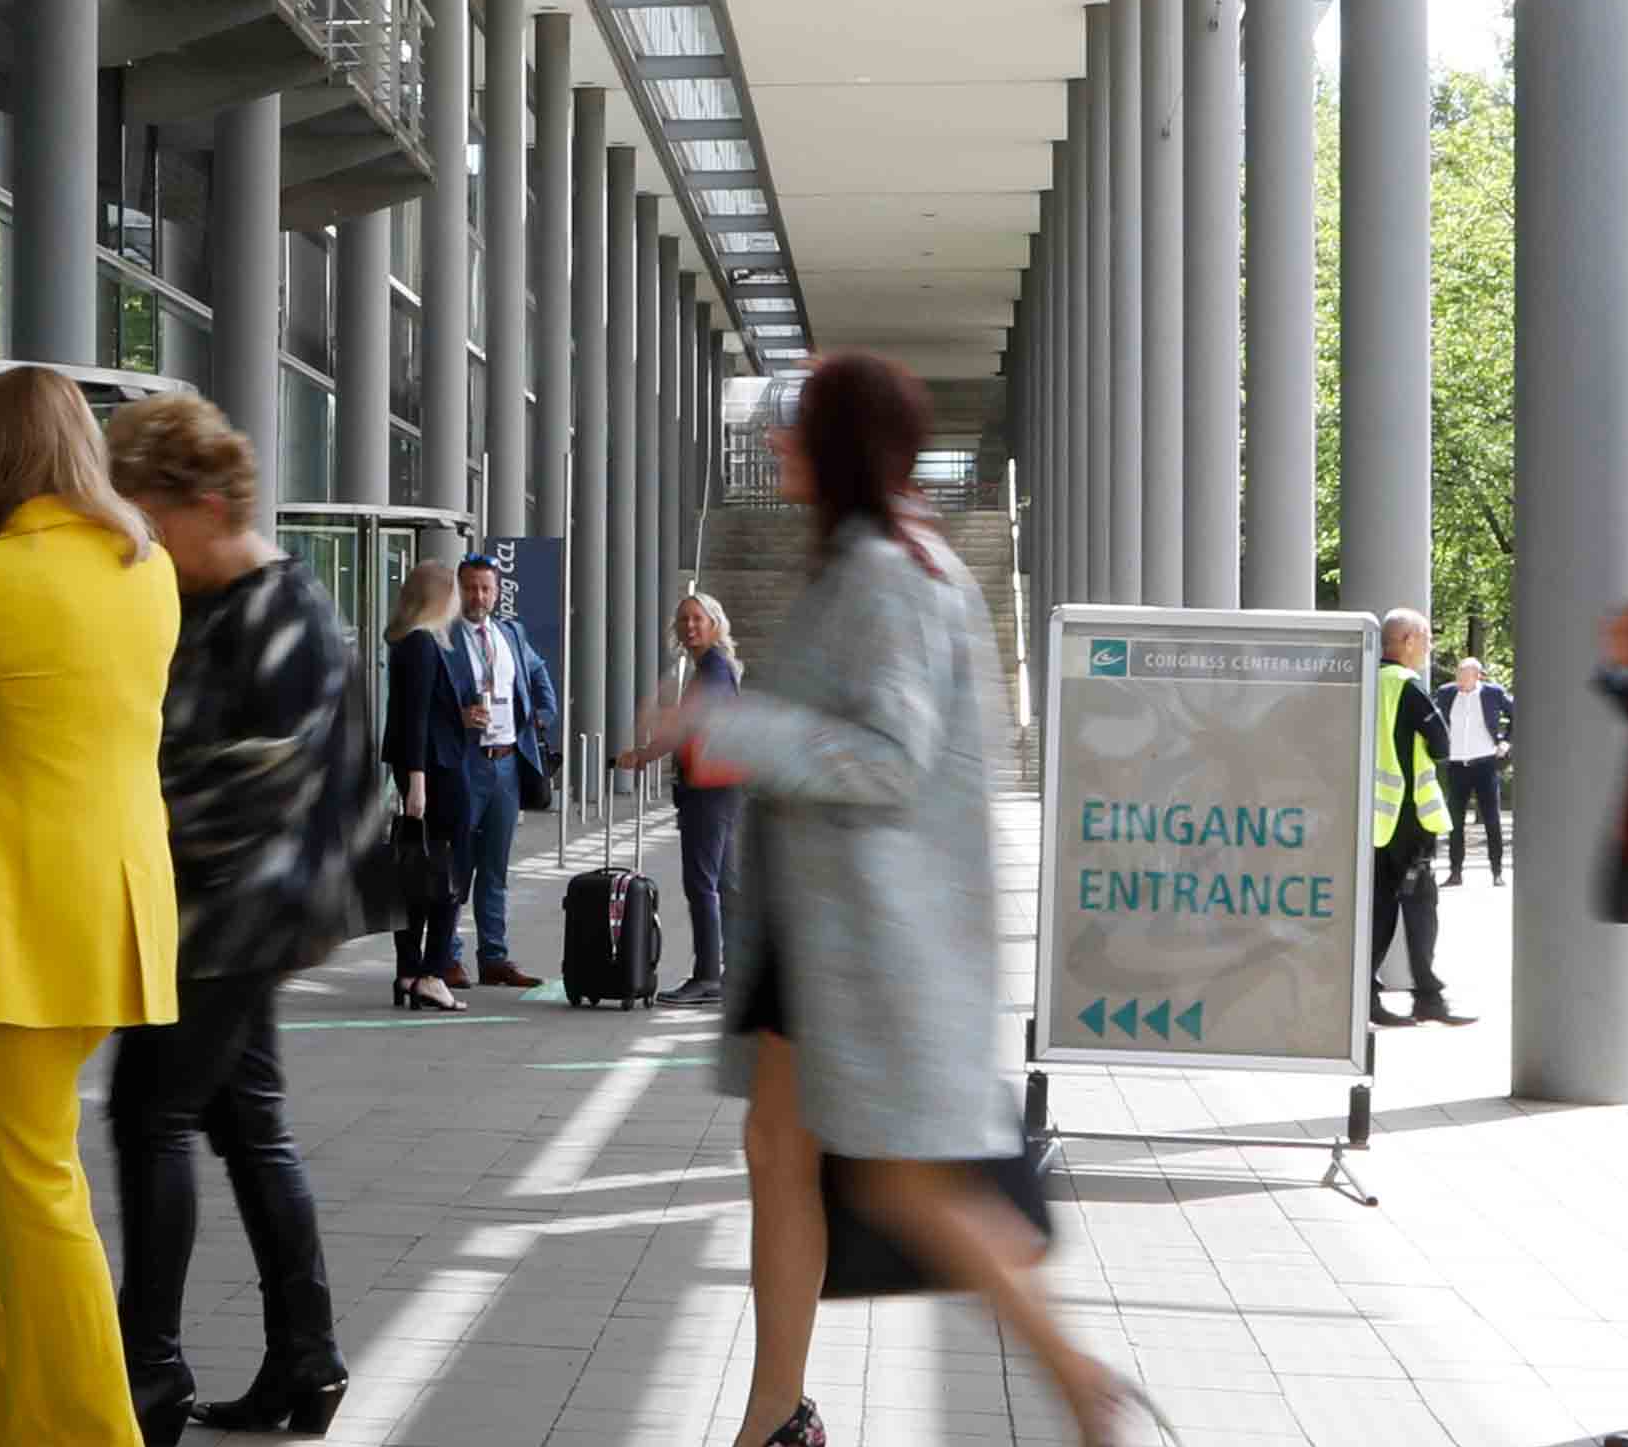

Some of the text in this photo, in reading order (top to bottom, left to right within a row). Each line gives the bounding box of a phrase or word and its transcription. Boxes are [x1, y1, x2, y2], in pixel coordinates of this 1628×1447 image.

[496, 540, 516, 574] CCL
[1144, 652, 1226, 670] CONGRESS
[1294, 657, 1356, 674] LEIPZIG
[1081, 801, 1307, 849] EINGANG
[1078, 869, 1335, 919] ENTRANCE
